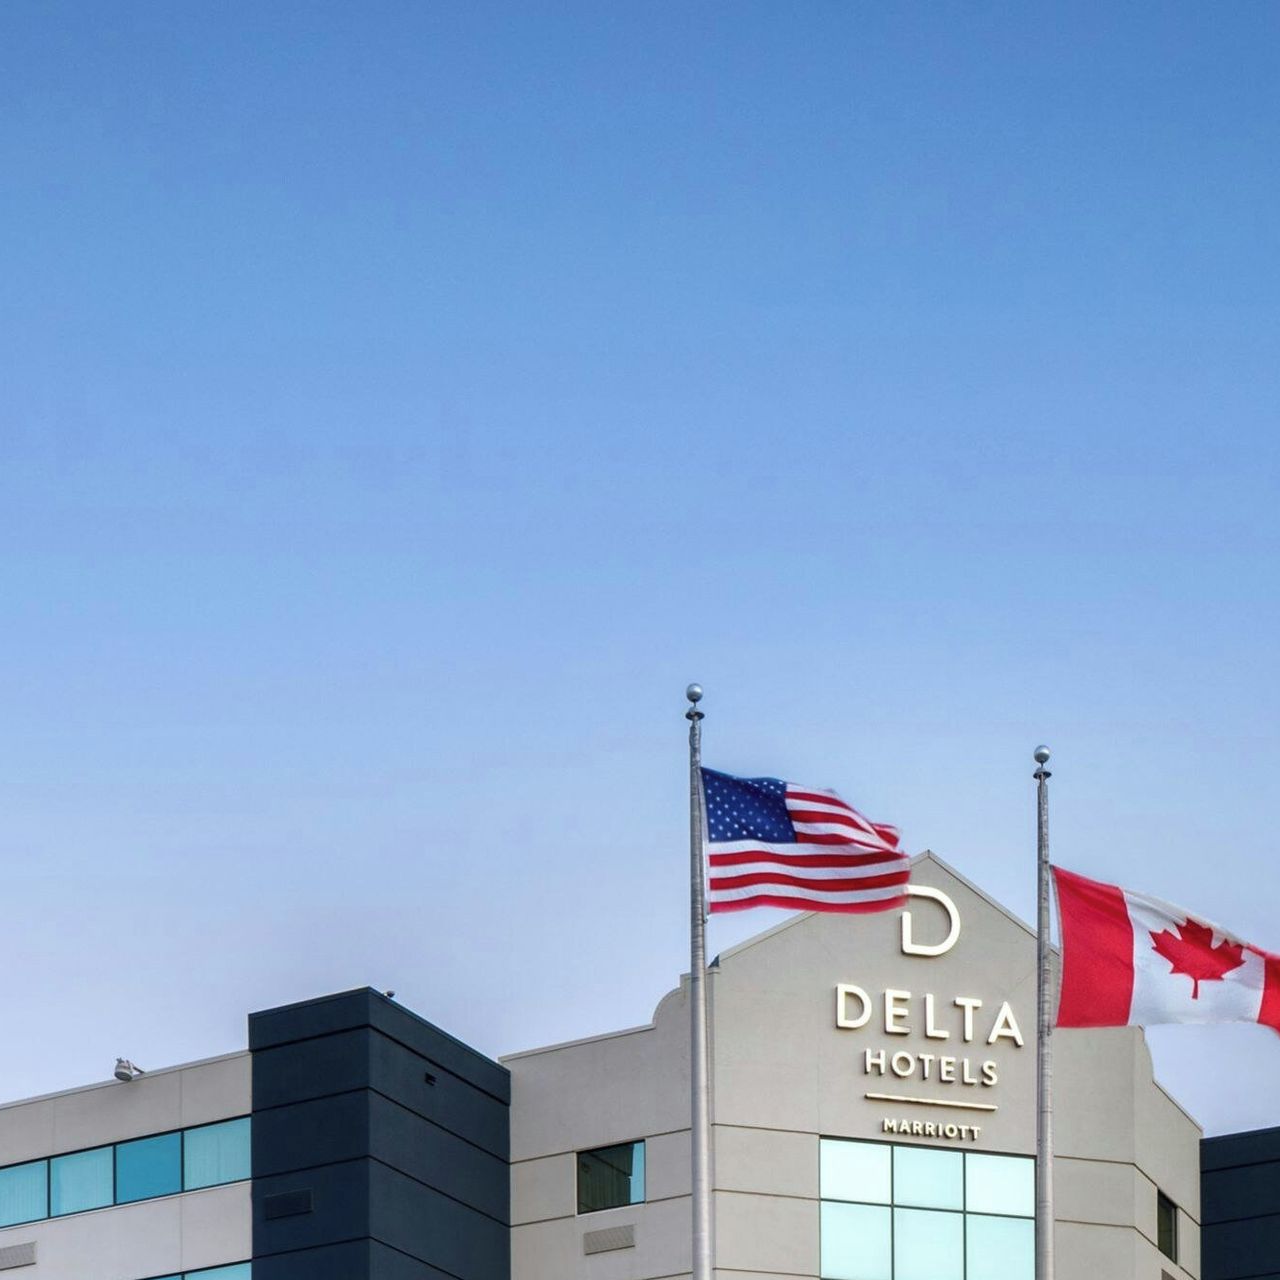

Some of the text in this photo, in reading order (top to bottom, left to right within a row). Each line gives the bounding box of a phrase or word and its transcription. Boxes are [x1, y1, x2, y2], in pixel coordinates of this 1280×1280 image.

[836, 983, 1024, 1047] DELTA
[864, 1048, 999, 1087] HOTELS
[882, 1117, 982, 1140] MARRIOTT
